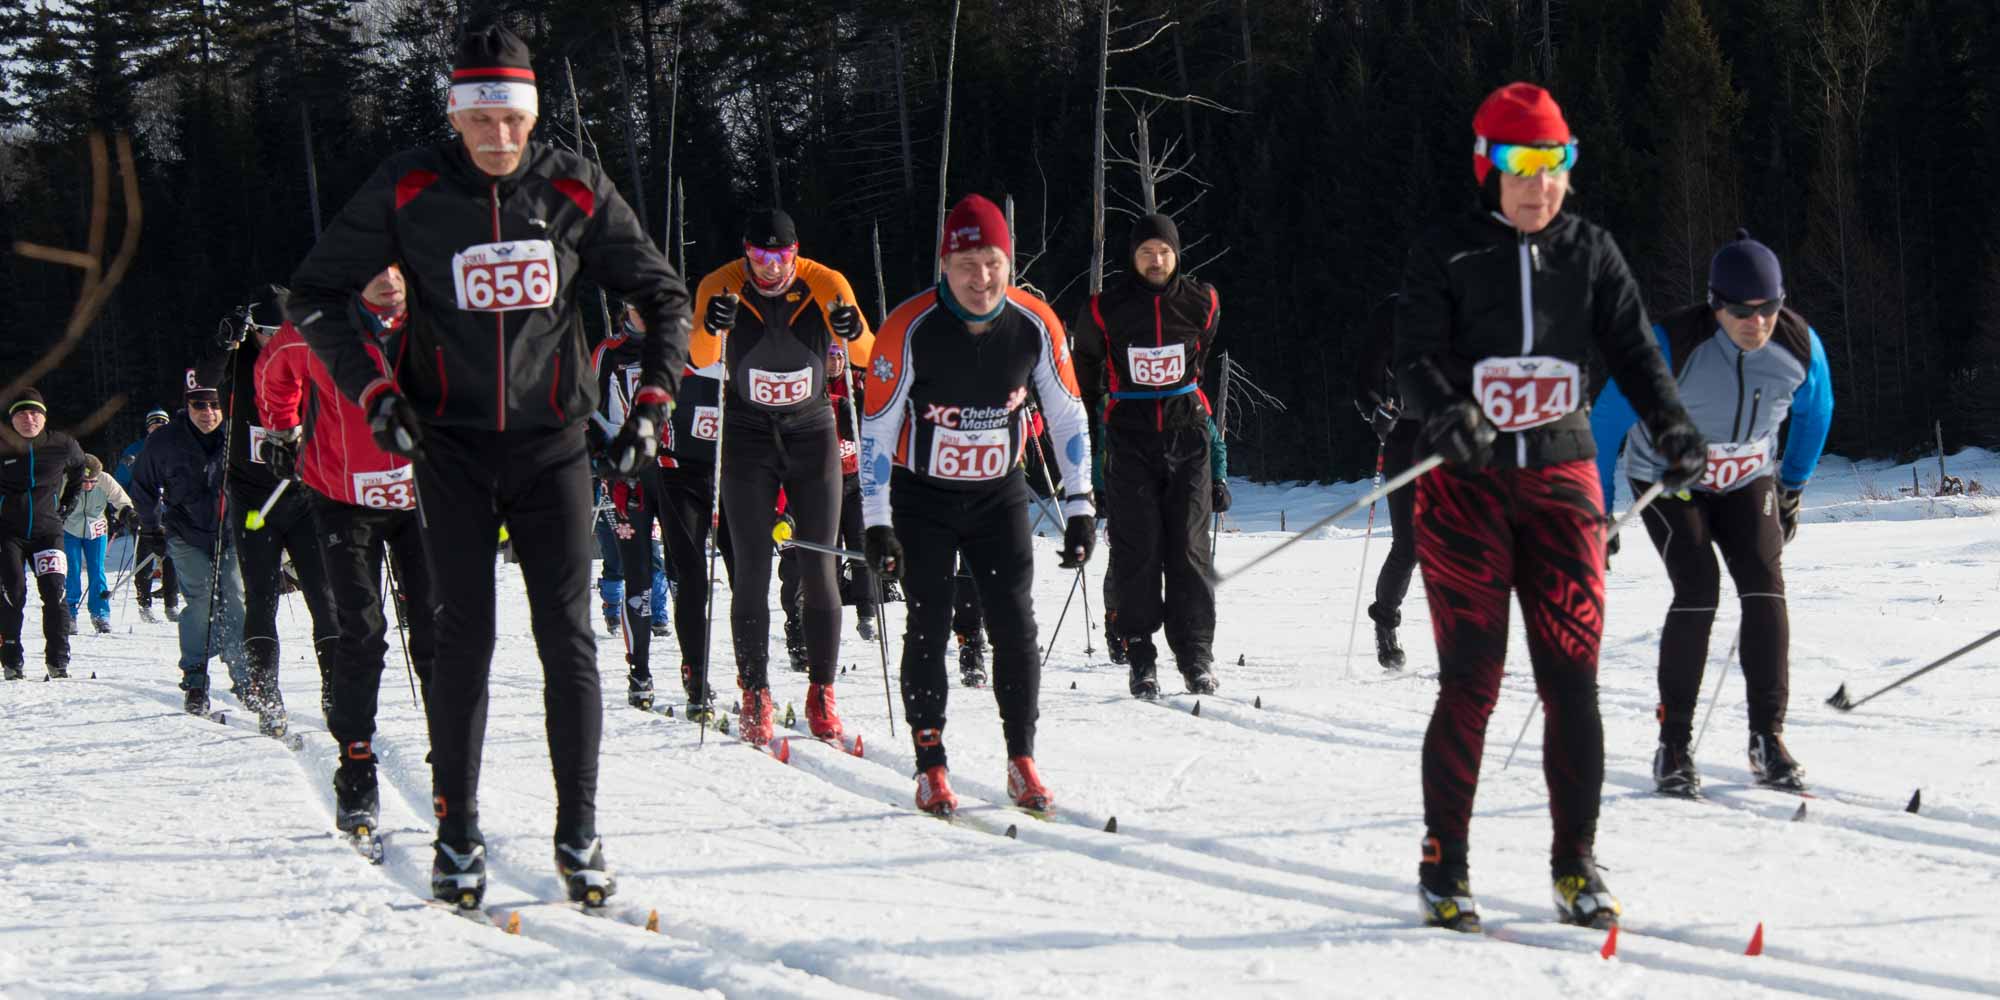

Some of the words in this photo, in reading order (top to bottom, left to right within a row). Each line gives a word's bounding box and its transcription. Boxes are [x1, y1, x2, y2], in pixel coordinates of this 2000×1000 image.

[466, 262, 551, 308] 656
[1135, 357, 1181, 382] 654
[755, 381, 807, 403] 619
[1483, 380, 1569, 425] 614
[924, 403, 960, 427] XC
[960, 406, 1009, 419] Chelsea
[960, 417, 1009, 430] Masters
[938, 447, 1004, 477] 610
[365, 483, 416, 508] 63
[38, 556, 63, 572] 64
